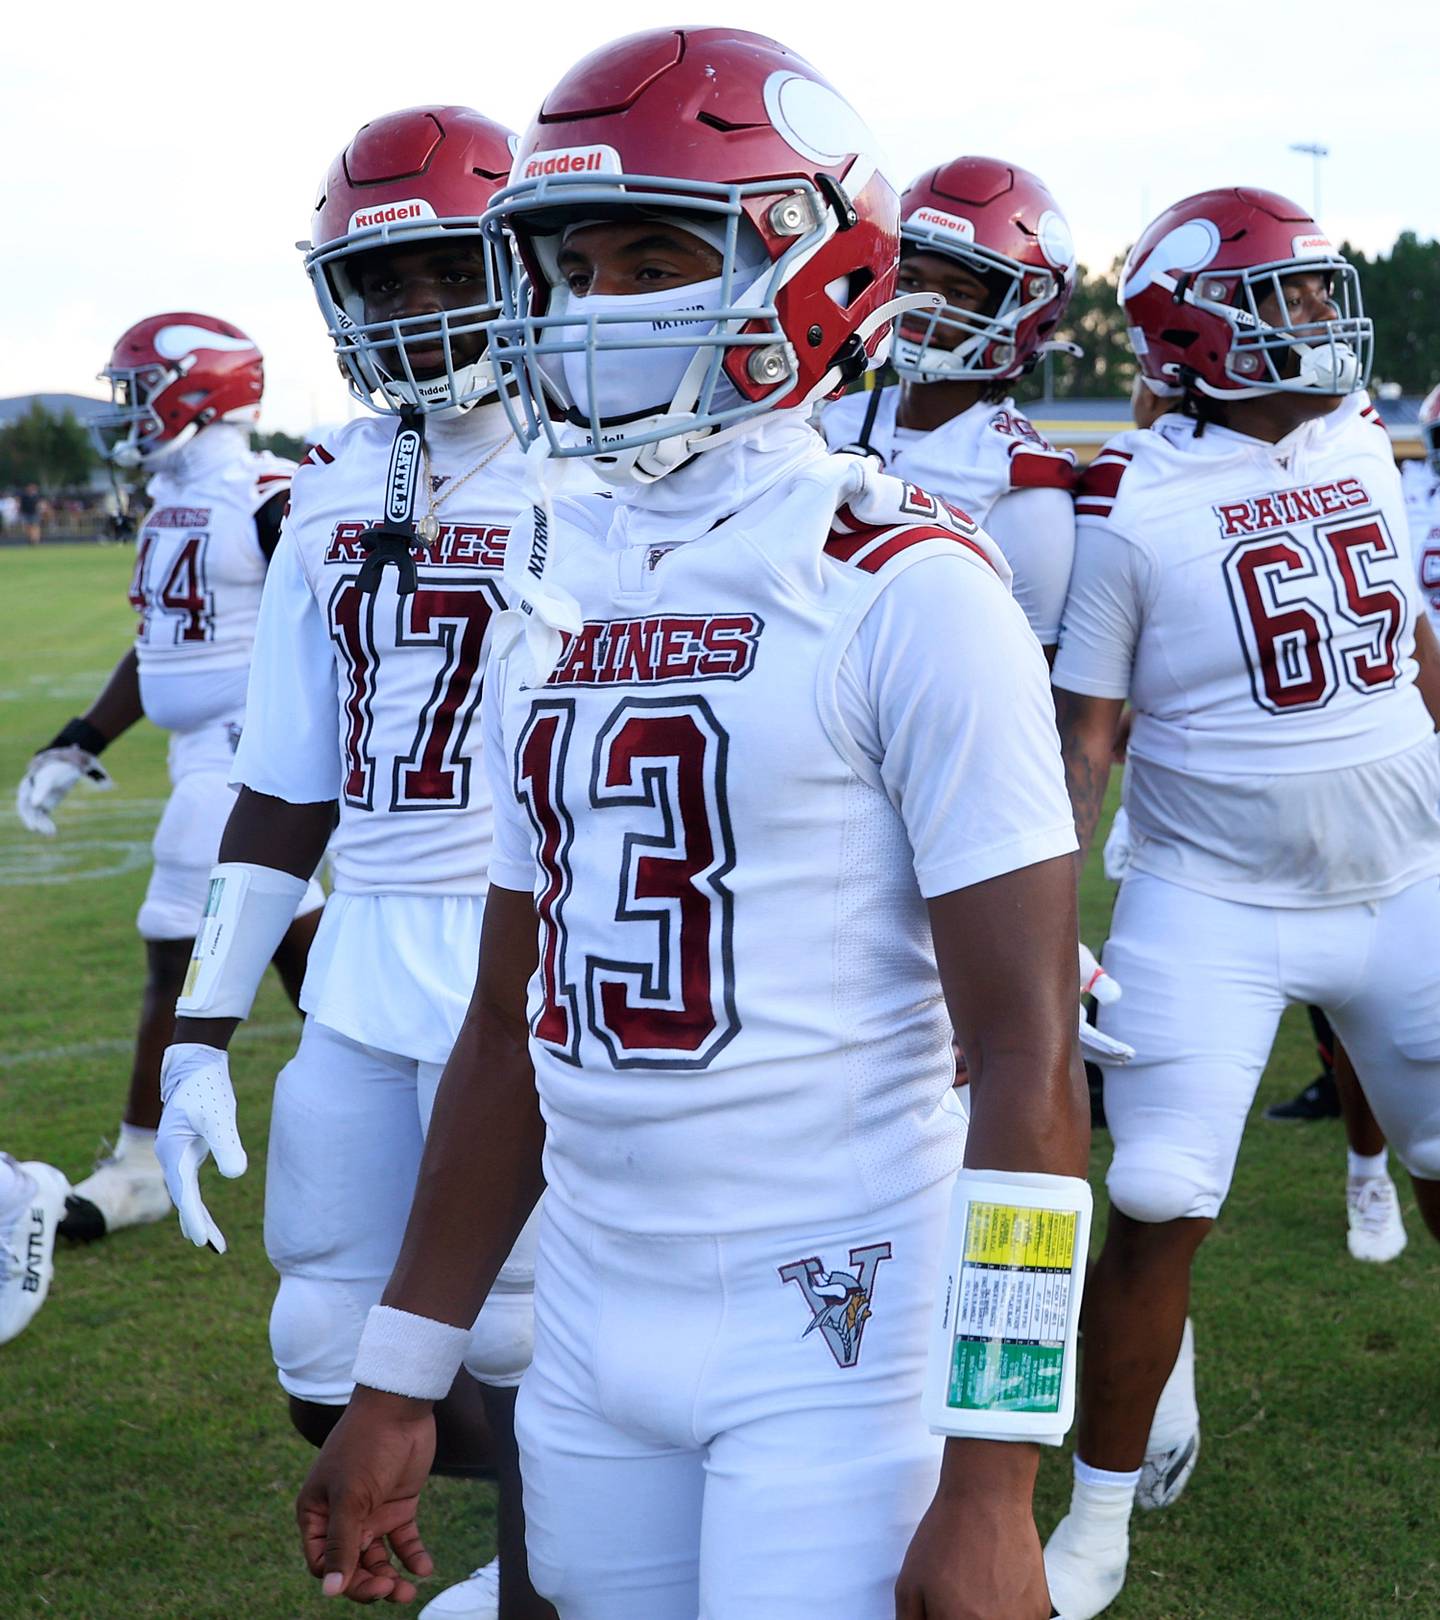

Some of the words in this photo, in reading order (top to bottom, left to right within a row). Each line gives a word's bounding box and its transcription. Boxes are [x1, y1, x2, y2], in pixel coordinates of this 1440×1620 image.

[525, 152, 602, 178] Riddell
[355, 204, 422, 228] Riddell
[391, 438, 416, 514] BATTLE
[1212, 478, 1371, 539] RAINES
[527, 504, 548, 580] NXTRND
[1222, 510, 1408, 716] 65
[327, 574, 510, 812] 17
[514, 694, 742, 1070] 13
[22, 1208, 44, 1292] BATTLE
